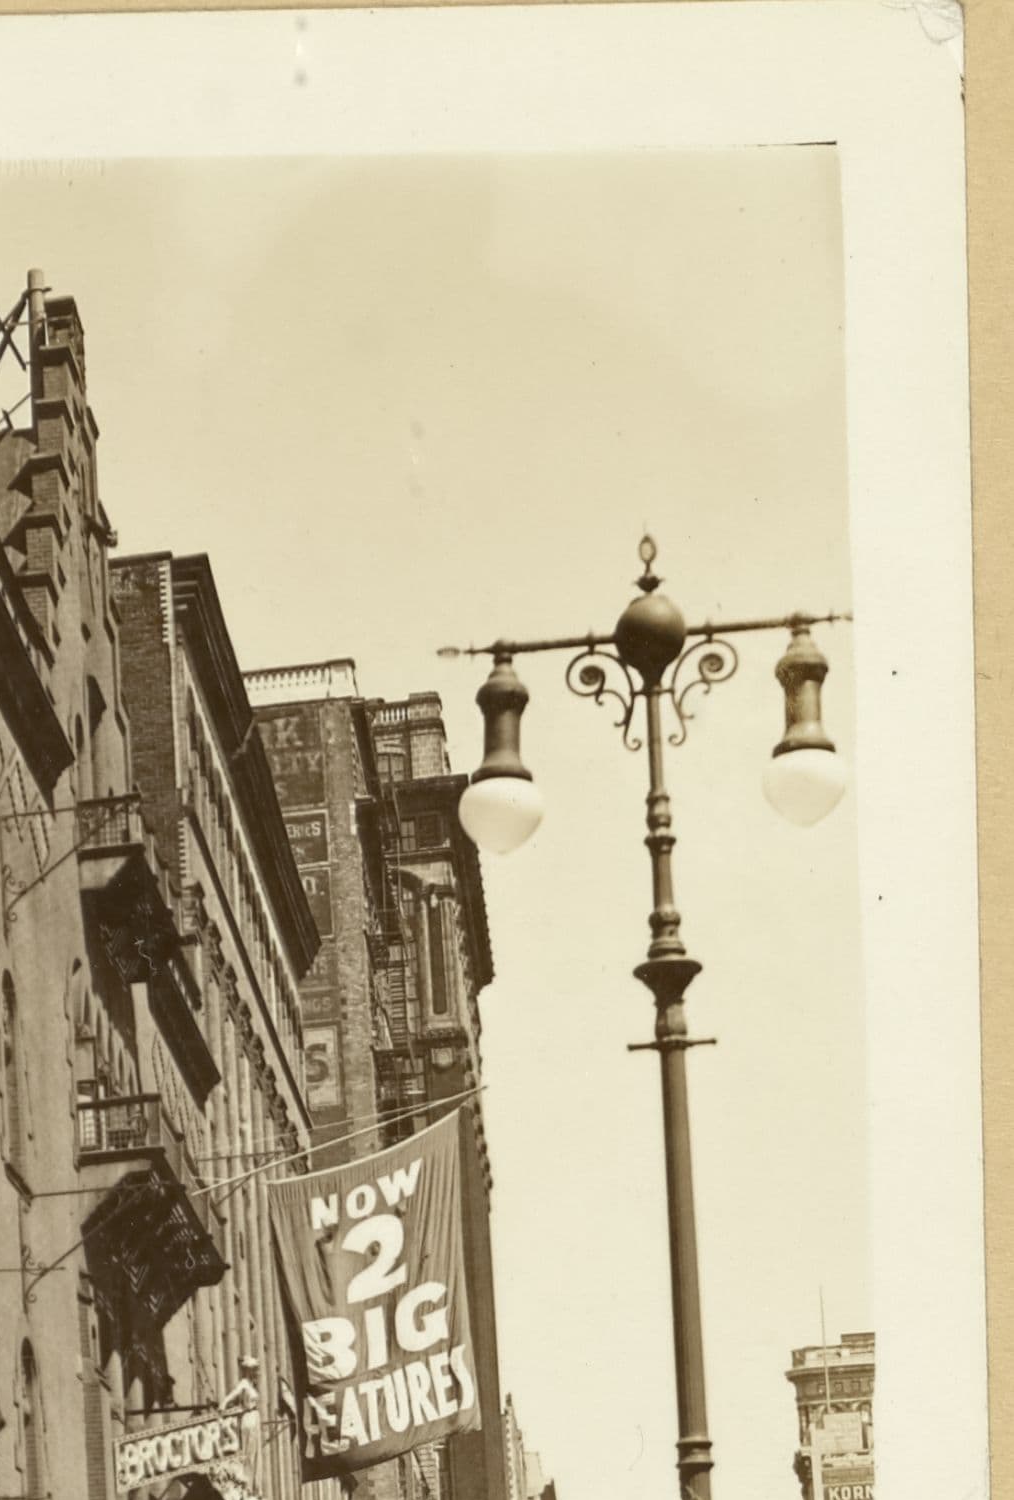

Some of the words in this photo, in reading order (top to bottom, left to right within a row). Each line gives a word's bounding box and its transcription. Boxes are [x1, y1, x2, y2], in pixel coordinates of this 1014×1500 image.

[310, 1157, 423, 1230] NOW
[341, 1214, 407, 1304] 2
[302, 1281, 449, 1387] BIG
[303, 1344, 476, 1458] FEATURES
